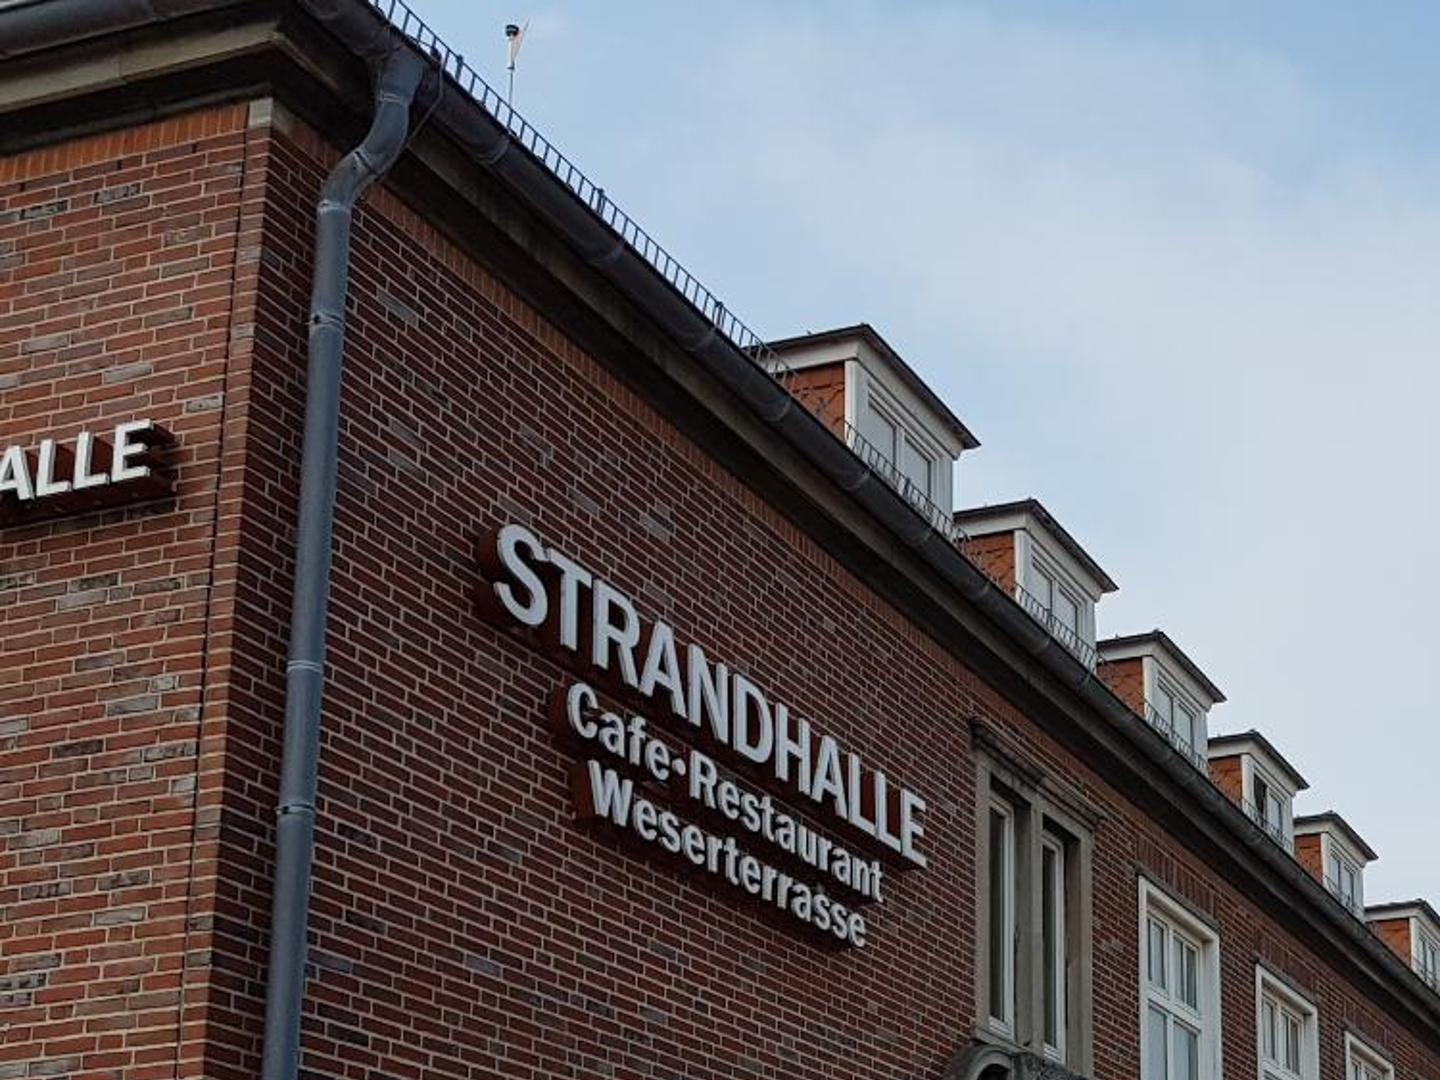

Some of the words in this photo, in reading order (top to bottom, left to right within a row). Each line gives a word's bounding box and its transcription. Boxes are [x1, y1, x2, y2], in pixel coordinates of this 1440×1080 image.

[0, 418, 154, 500] ALLE
[494, 523, 927, 867] STRANDHALLE
[588, 759, 867, 948] Weserterrasse
